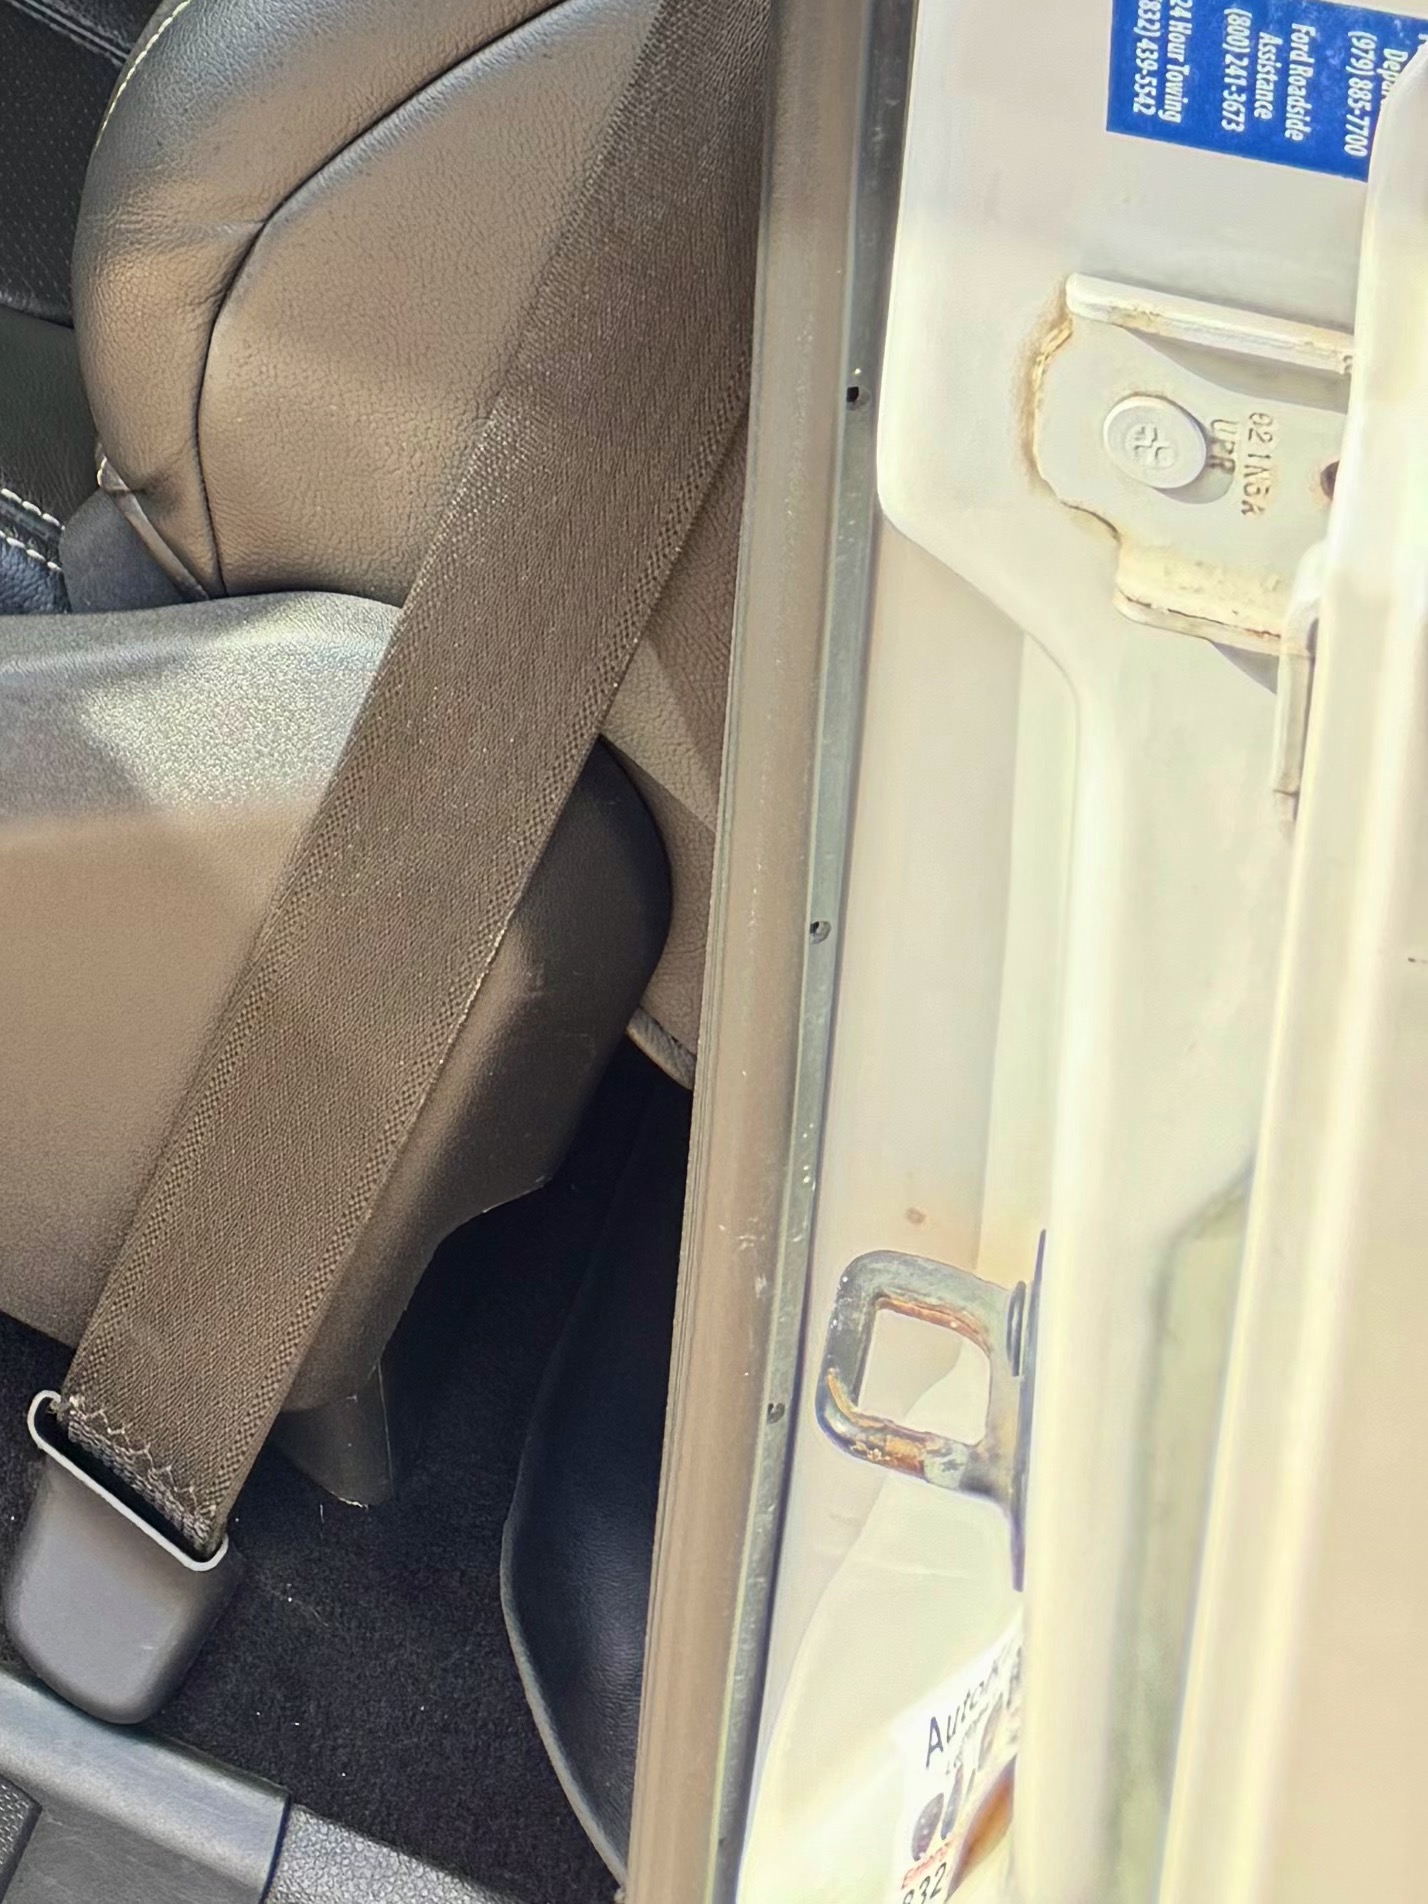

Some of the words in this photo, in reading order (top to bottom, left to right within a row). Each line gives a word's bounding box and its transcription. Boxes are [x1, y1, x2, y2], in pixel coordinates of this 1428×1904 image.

[1167, 20, 1192, 61] Hour
[1223, 8, 1253, 53] (800)
[1290, 23, 1316, 59] Ford
[1345, 31, 1378, 75] (979)
[1132, 38, 1159, 115] 439-5542
[1156, 63, 1188, 124] Towing
[1221, 54, 1247, 132] 241-3673
[1253, 32, 1283, 119] Assistance
[1284, 62, 1314, 141] Roadside
[1344, 77, 1373, 157] 885-7700
